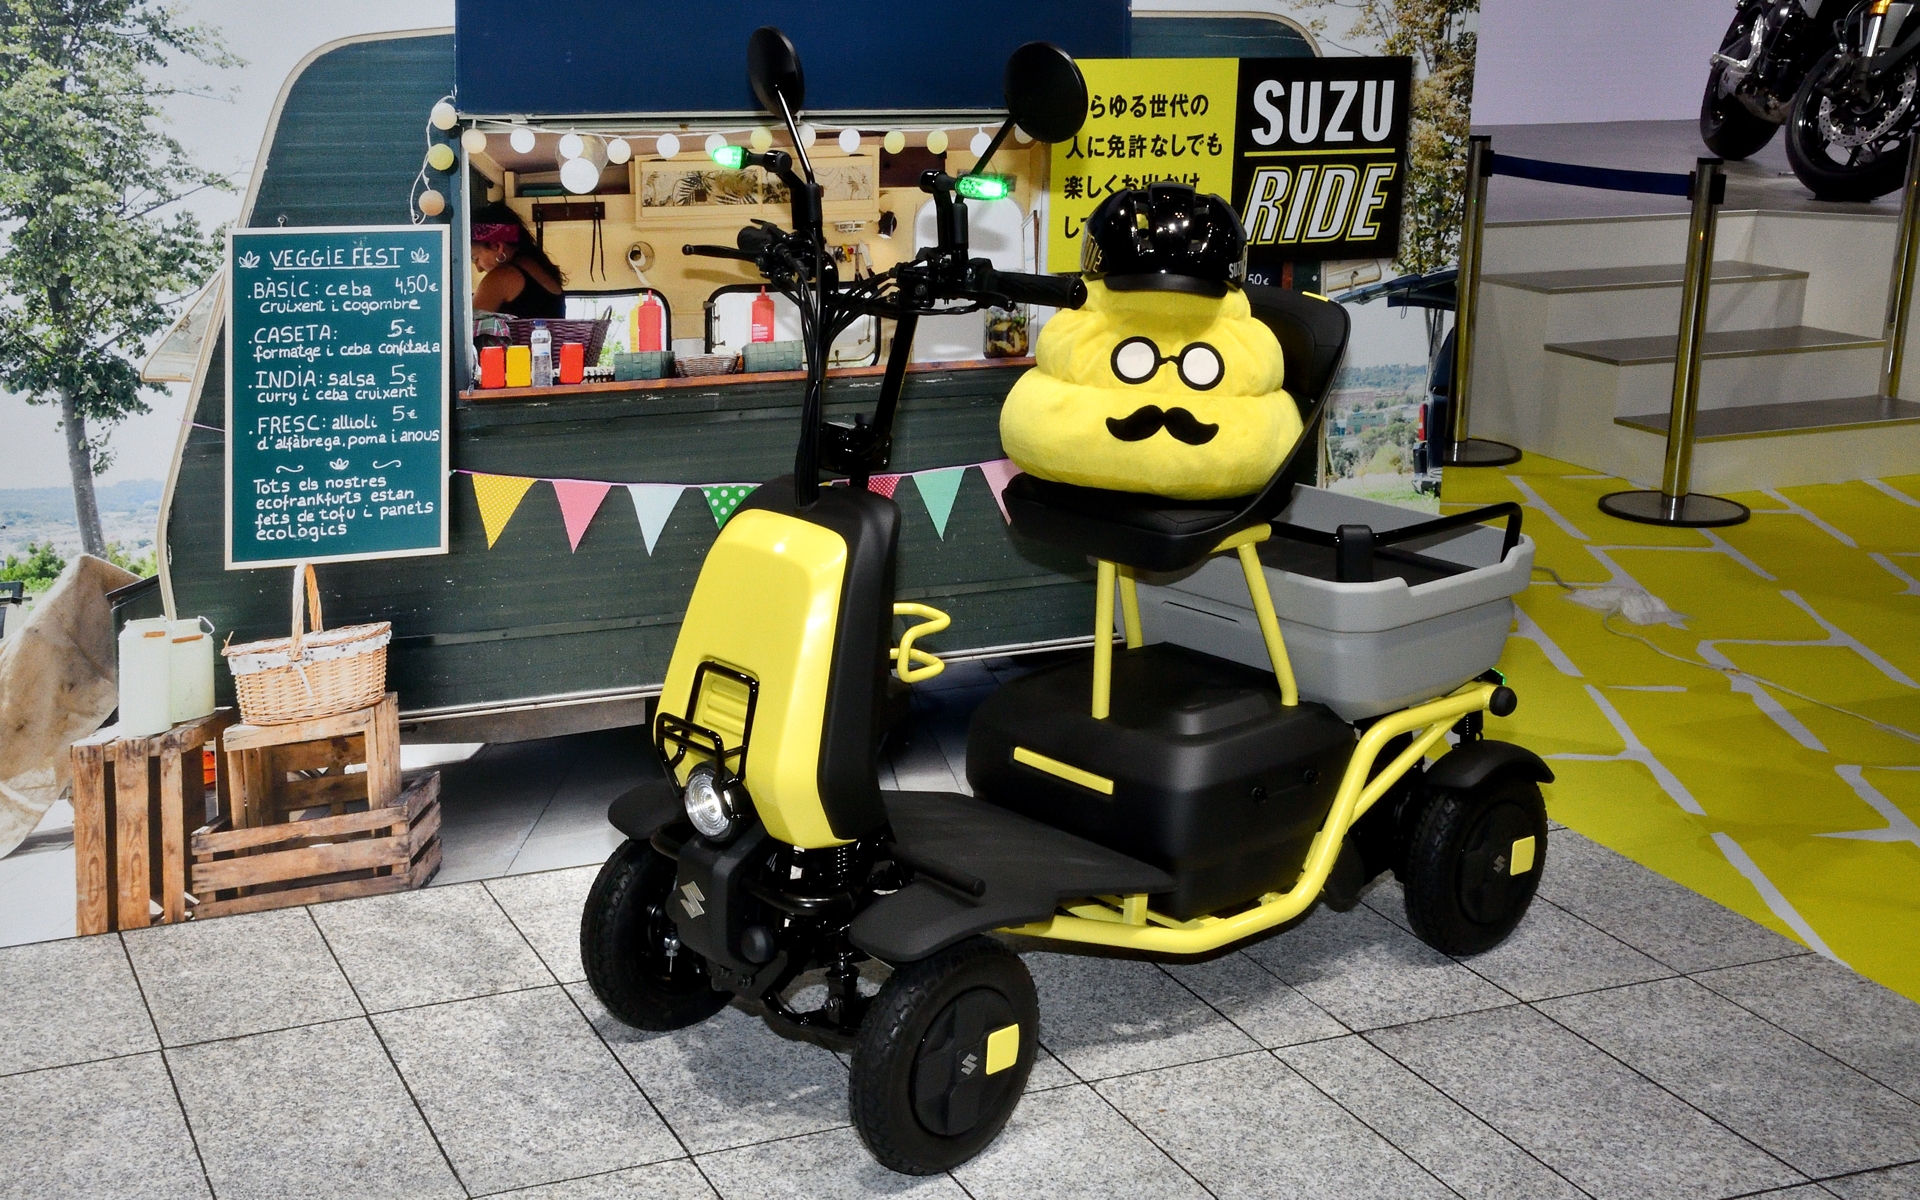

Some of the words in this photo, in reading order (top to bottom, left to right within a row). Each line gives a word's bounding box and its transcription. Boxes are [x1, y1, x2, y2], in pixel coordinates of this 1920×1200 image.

[1089, 94, 1209, 119] らゆる世代の
[1251, 79, 1395, 146] SUZU
[1065, 132, 1223, 159] 人に免許なしでも
[1243, 162, 1397, 245] RIDE
[352, 247, 404, 266] FEST
[325, 280, 372, 297] ceba
[394, 274, 439, 296] 4,50€
[259, 299, 326, 314] cruixent
[342, 298, 421, 315] cogombre
[386, 318, 416, 338] 5€
[253, 345, 321, 362] formatge
[339, 342, 373, 356] ceba
[327, 370, 376, 387] salsa
[389, 364, 418, 385] 5€
[257, 391, 297, 406] curry
[315, 387, 350, 402] ceba
[354, 384, 418, 400] cruixent
[331, 413, 378, 431] allioli
[392, 405, 418, 421] 5€
[399, 428, 441, 443] anous
[253, 478, 290, 494] Tots
[298, 477, 319, 491] els
[324, 475, 388, 490] nostres
[256, 491, 362, 511] ecofrankfurts
[370, 488, 415, 502] estan
[255, 513, 290, 530] fets
[297, 510, 315, 523] de
[318, 506, 357, 523] tofu
[379, 501, 434, 520] panets
[256, 524, 347, 542] ecològics
